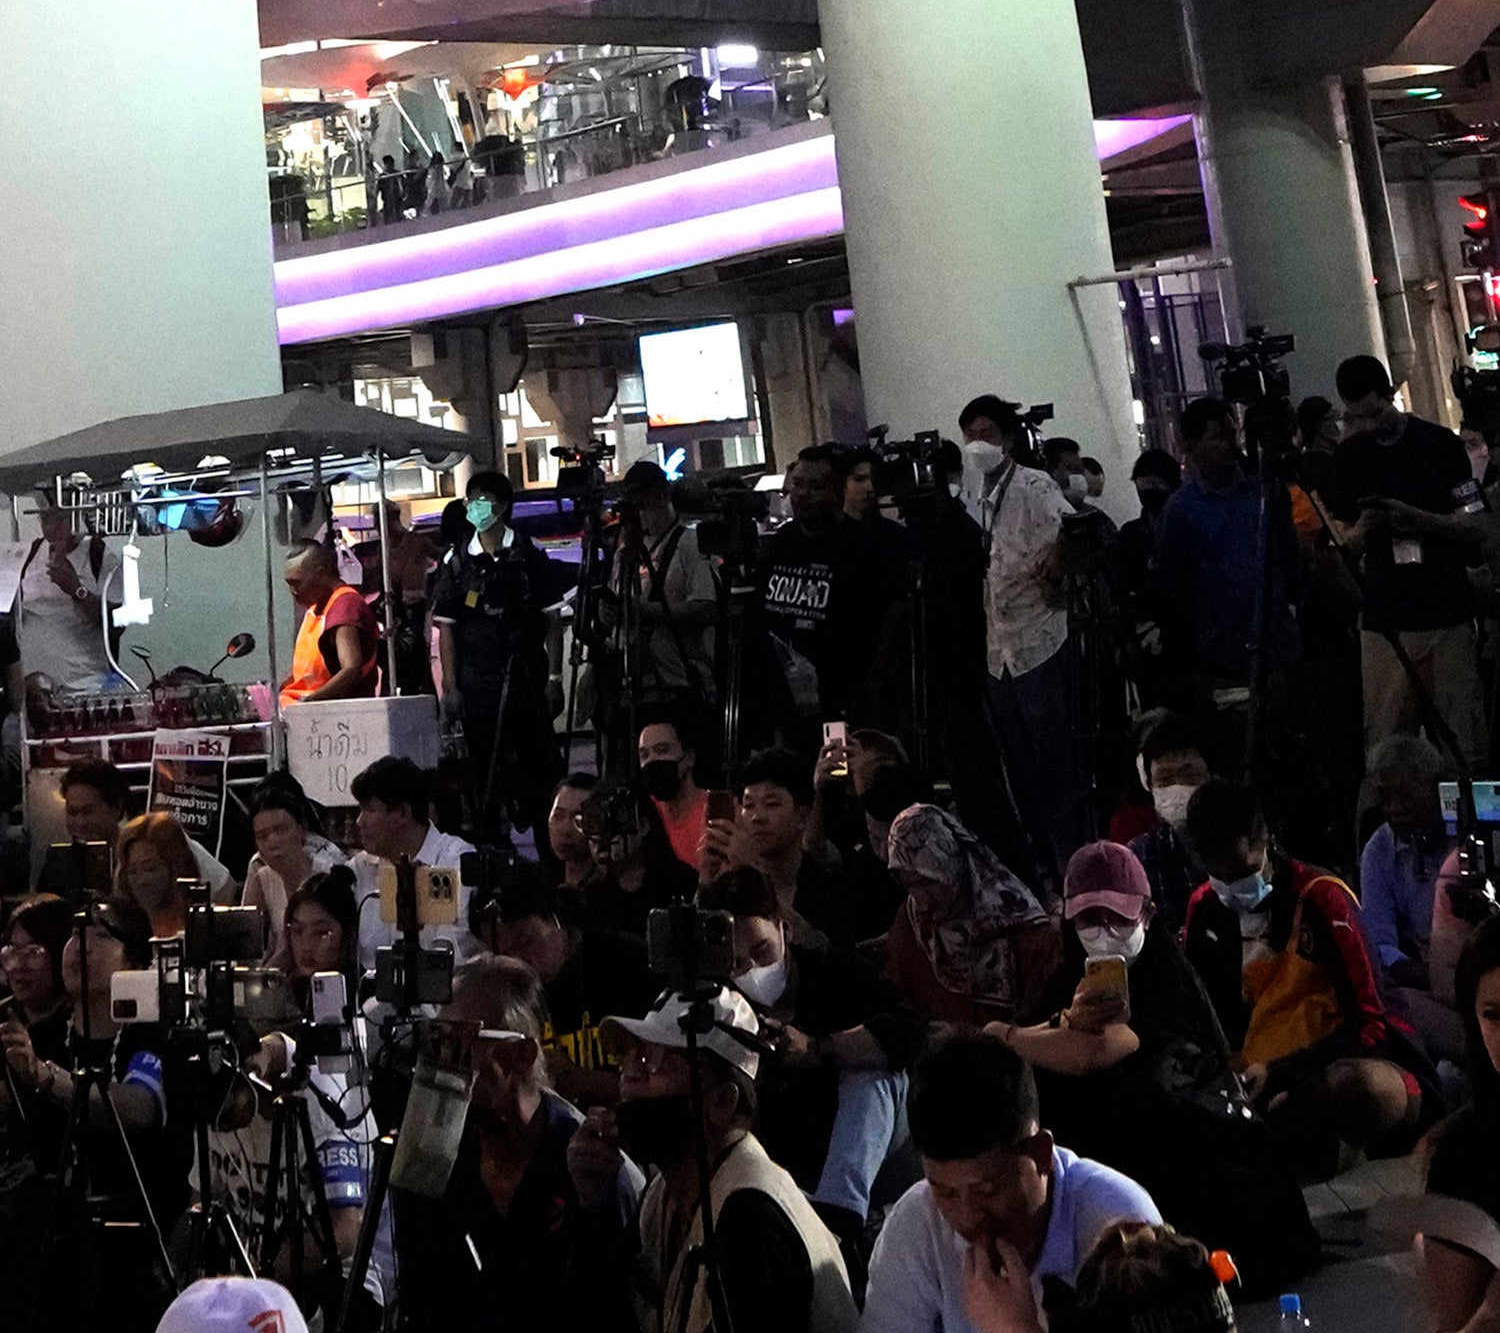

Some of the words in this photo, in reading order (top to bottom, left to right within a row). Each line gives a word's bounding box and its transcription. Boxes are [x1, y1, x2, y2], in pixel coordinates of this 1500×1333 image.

[765, 574, 830, 609] SQUAD
[328, 764, 348, 793] 10
[318, 1146, 359, 1168] RESS
